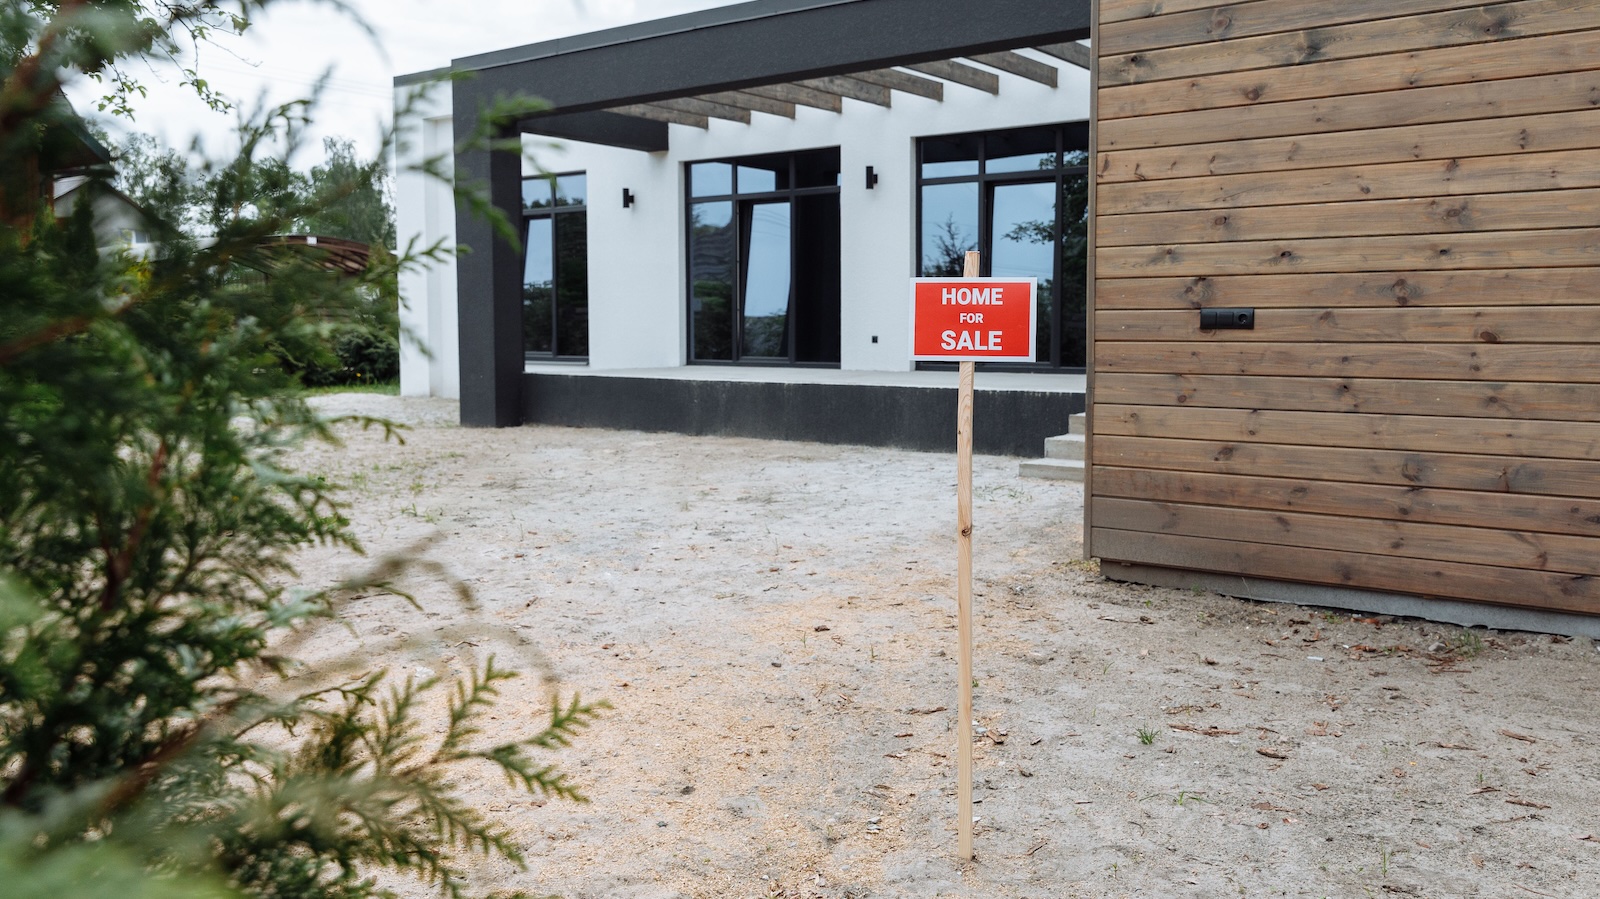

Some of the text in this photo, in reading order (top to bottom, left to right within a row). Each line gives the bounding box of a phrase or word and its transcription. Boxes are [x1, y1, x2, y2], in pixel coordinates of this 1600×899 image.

[941, 287, 1004, 305] HOME
[959, 312, 984, 324] FOR
[940, 330, 1003, 351] SALE
